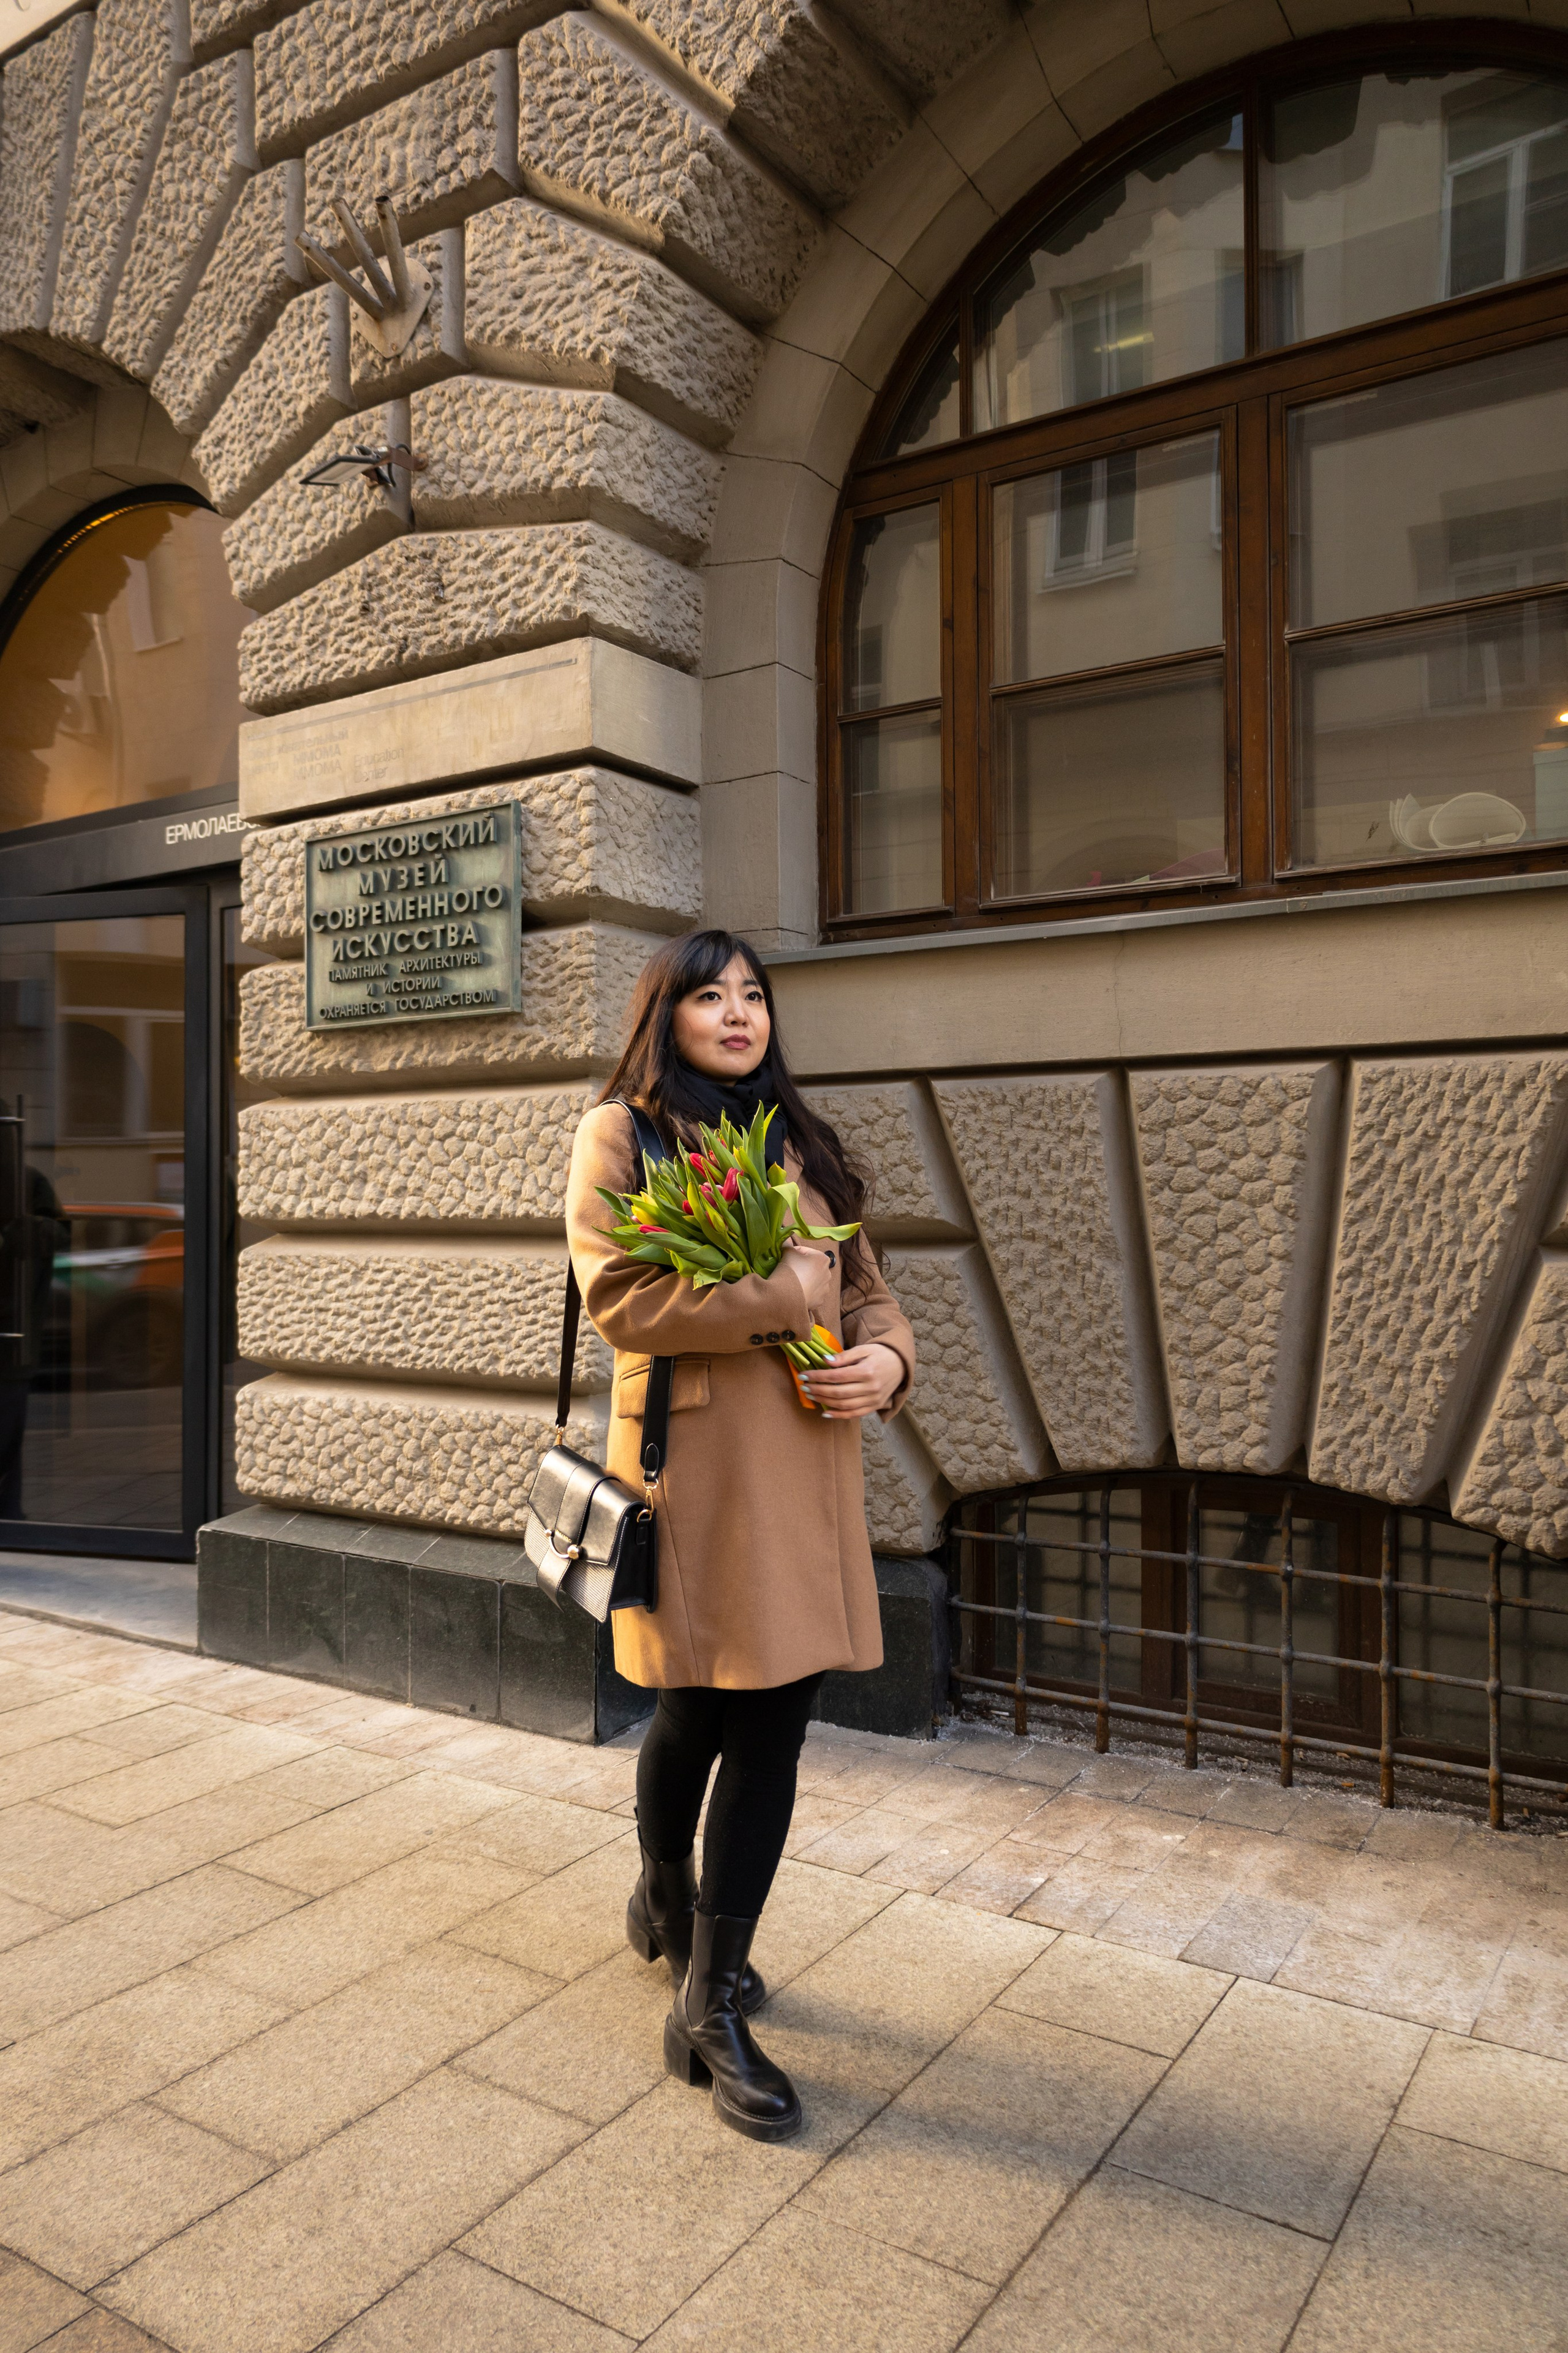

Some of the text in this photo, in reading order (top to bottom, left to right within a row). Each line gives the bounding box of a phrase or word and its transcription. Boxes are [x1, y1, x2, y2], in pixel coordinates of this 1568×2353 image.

[166, 812, 260, 844] ЕРМОЛАЕВ
[318, 812, 497, 871] МОСКОВСКИЙ
[358, 854, 449, 896] МУЗЕЙ
[310, 884, 504, 932] СОВРЕМЕННОГО
[333, 921, 481, 962] ИСКУССТВА
[329, 952, 483, 981] ПАМЯТНИК АРХИТЕКТУРЫ
[366, 976, 442, 995] И ИСТОРИИ
[319, 989, 497, 1019] ОХРАНЯЕТСЯ ГОСУДАРСТВОМ
